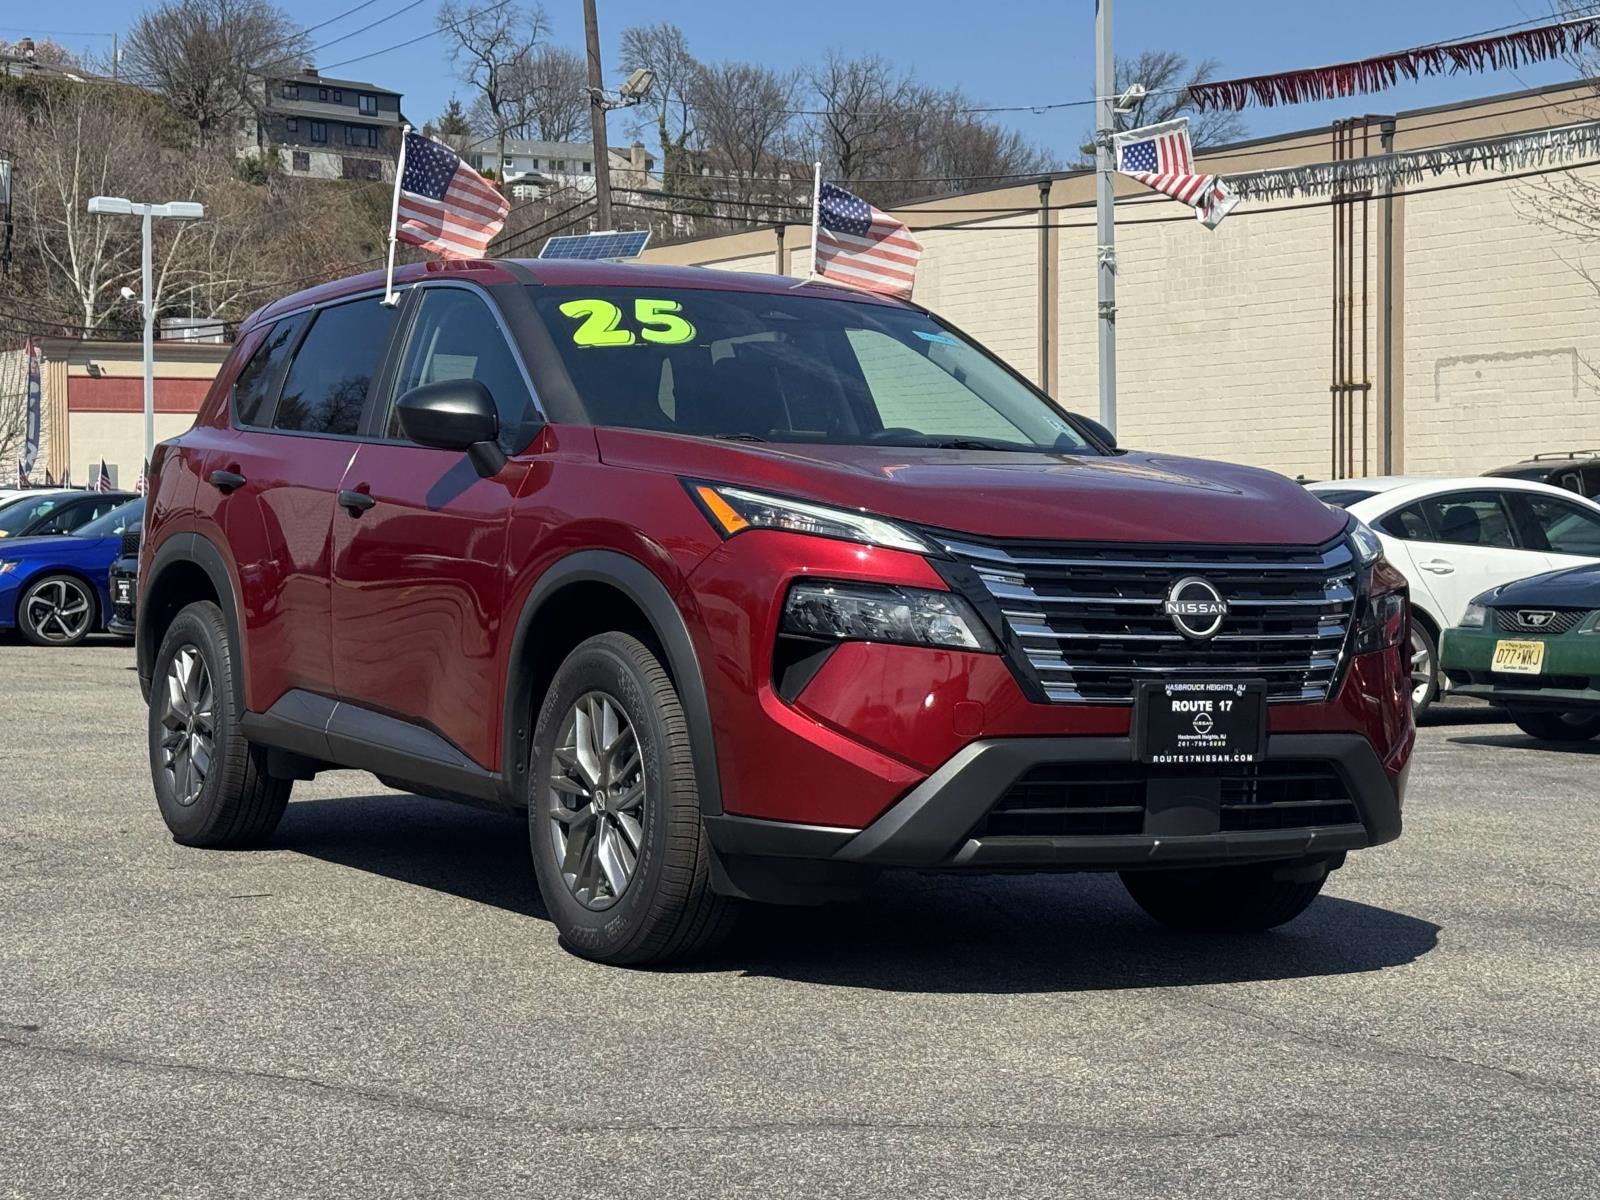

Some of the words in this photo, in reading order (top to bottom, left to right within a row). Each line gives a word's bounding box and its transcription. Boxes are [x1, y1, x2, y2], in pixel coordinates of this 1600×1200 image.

[559, 299, 697, 347] 25
[1167, 603, 1227, 613] NISSAN
[1165, 683, 1205, 691] HASBROUCK
[1172, 700, 1213, 712] ROUTE
[1218, 700, 1233, 712] 17
